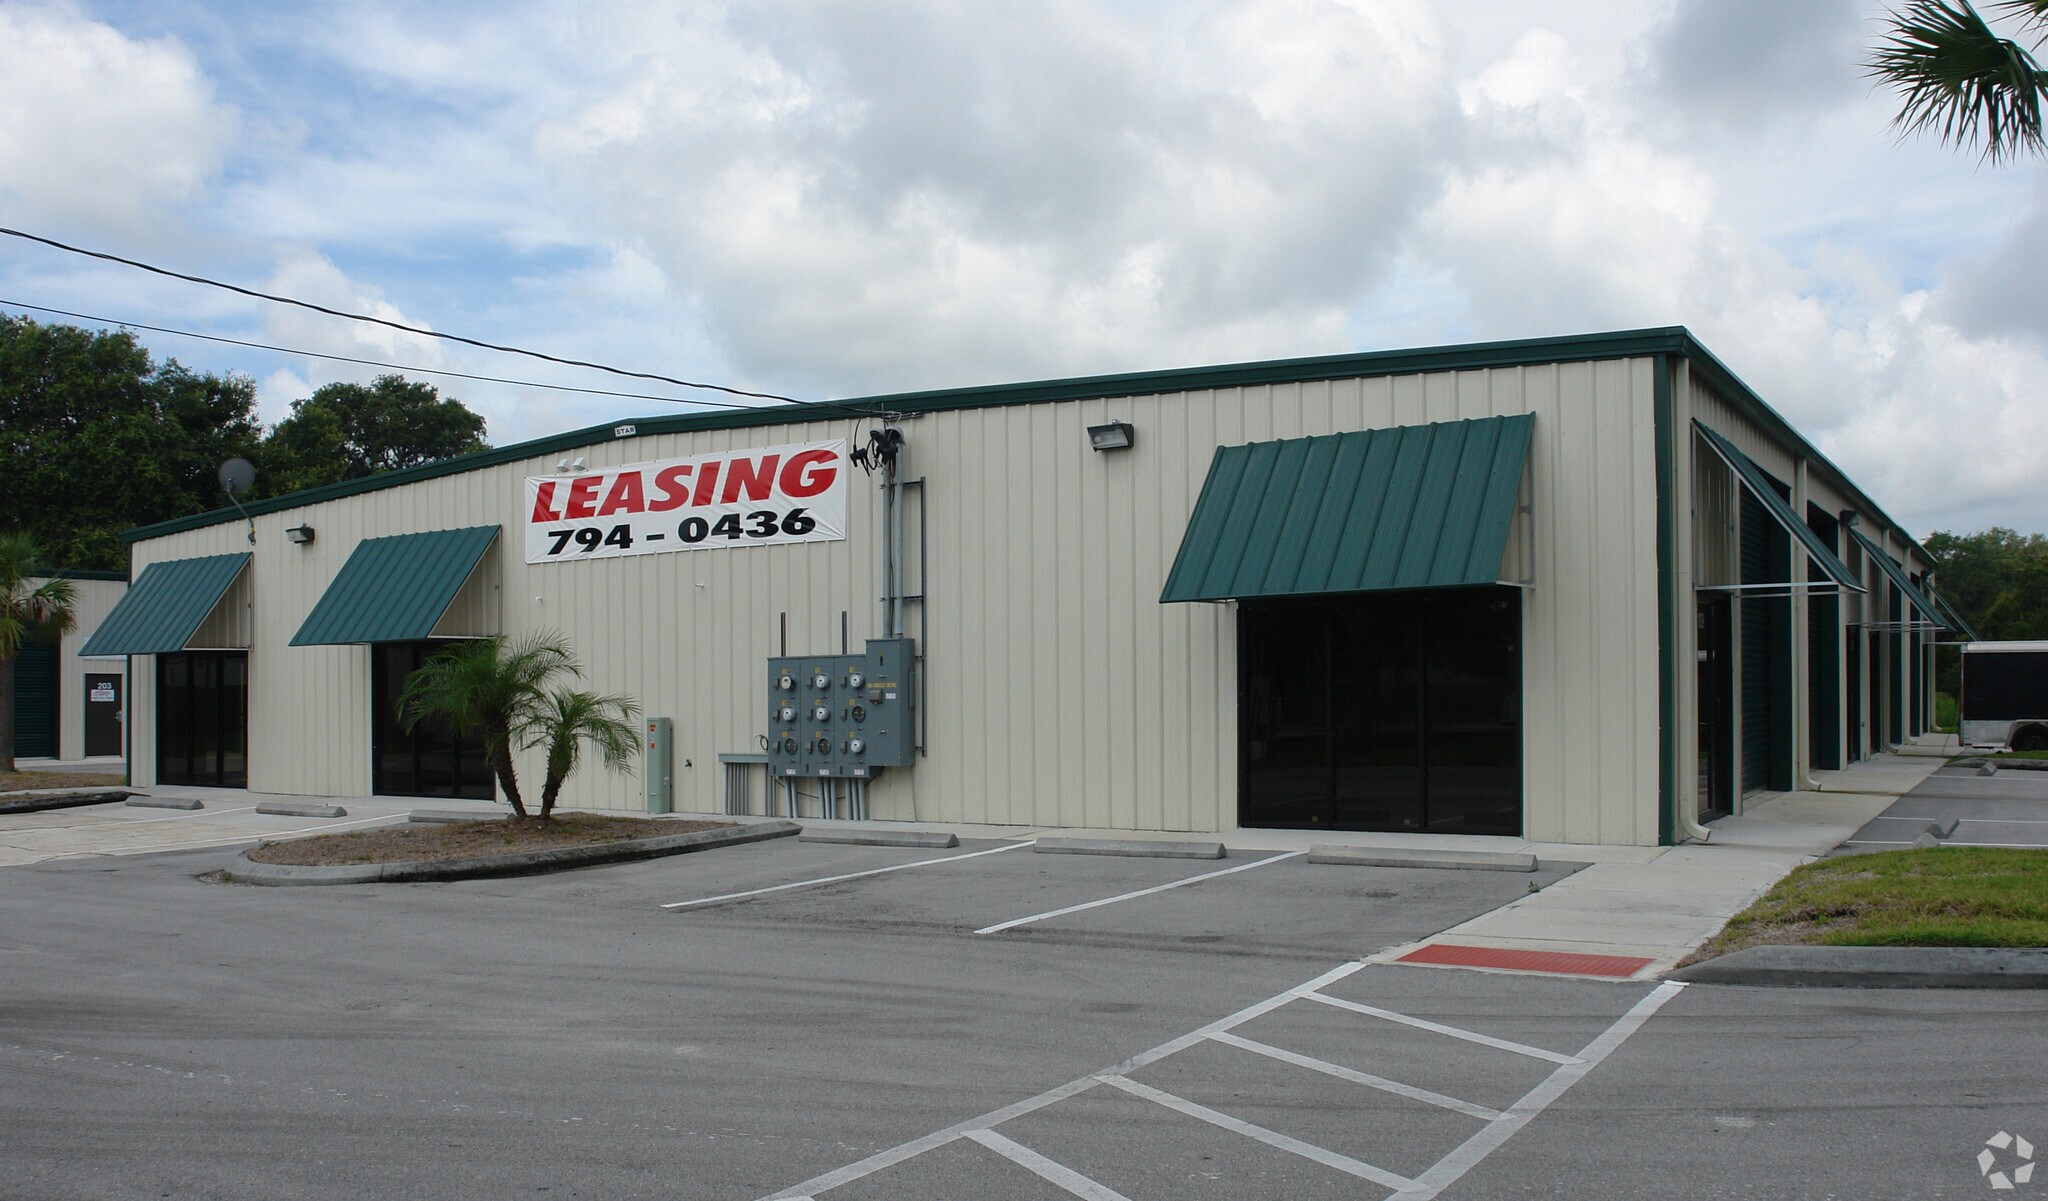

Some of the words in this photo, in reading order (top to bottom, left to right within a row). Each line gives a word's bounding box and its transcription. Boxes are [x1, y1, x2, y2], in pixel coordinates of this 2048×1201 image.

[616, 427, 635, 435] STAR
[531, 449, 838, 523] LEASING
[547, 524, 633, 555] 794
[677, 508, 816, 543] 0436
[97, 682, 112, 690] 203
